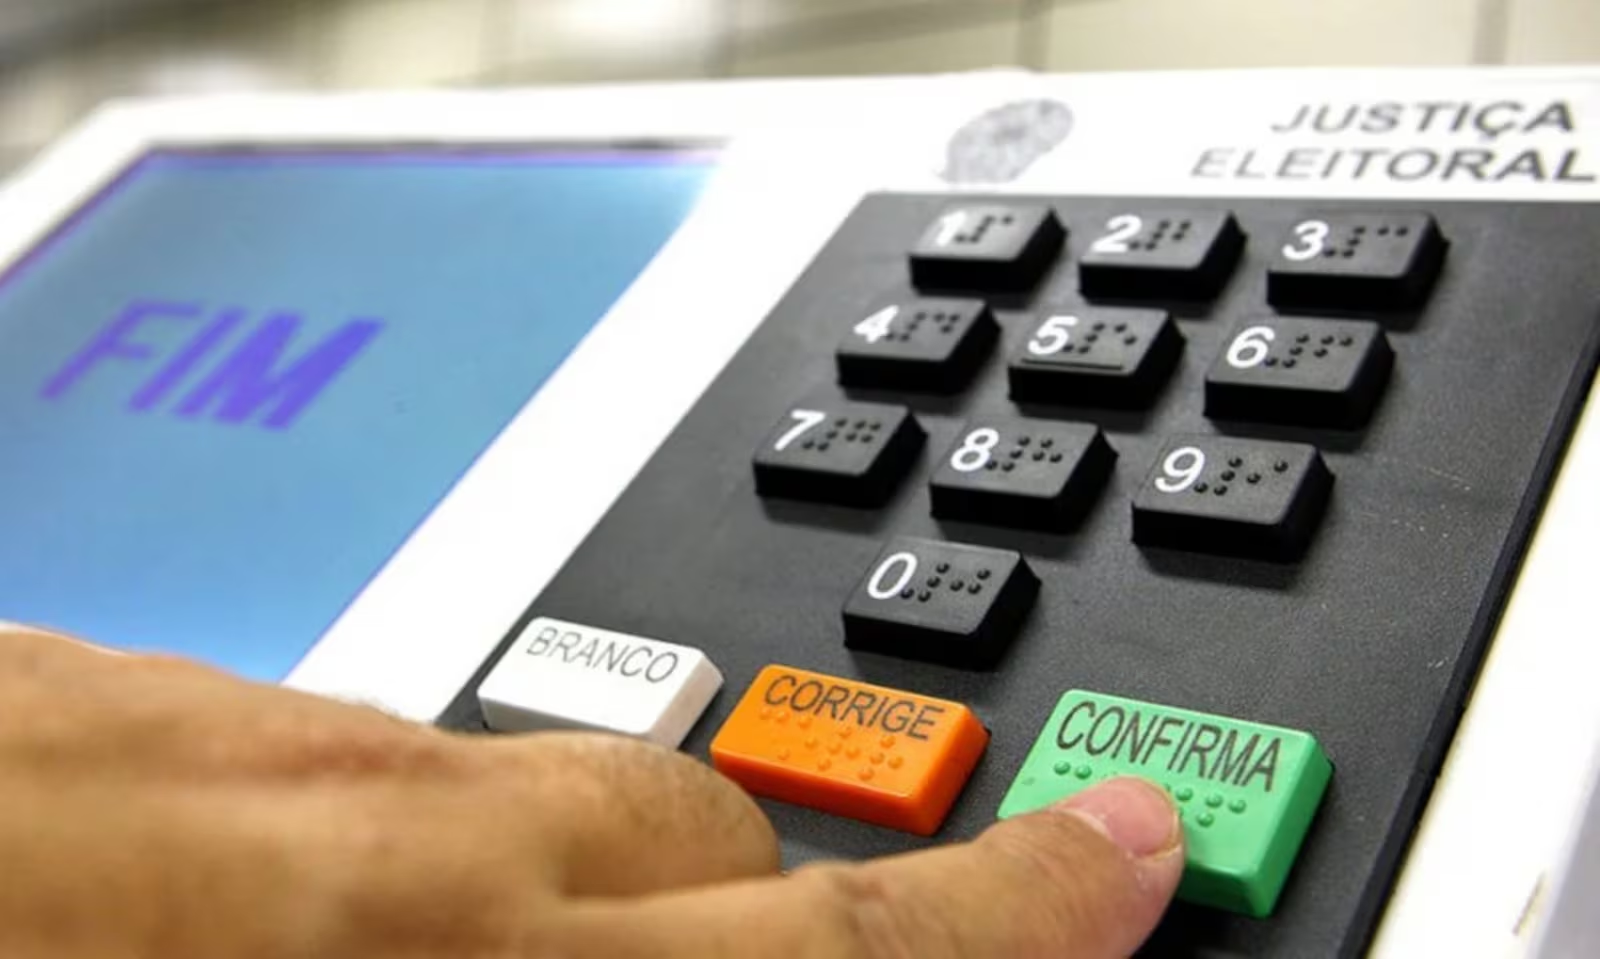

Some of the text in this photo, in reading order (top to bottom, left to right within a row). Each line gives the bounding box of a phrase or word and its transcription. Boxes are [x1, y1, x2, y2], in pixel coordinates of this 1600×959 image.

[1271, 101, 1574, 139] JUSTIÇA
[1190, 148, 1596, 182] ELEITORAL
[934, 211, 965, 245] 1
[1094, 215, 1142, 252] 2
[1282, 221, 1329, 260] 3
[854, 305, 899, 342] 4
[1027, 316, 1077, 355] 5
[40, 300, 384, 430] FIM
[1226, 327, 1275, 368] 6
[774, 411, 825, 451] 7
[950, 428, 999, 471] 8
[1155, 447, 1205, 492] 9
[867, 553, 917, 599] 0
[525, 627, 679, 684] BRANCO
[764, 675, 945, 742] CORRIGE
[1056, 701, 1281, 793] CONFIRMA
